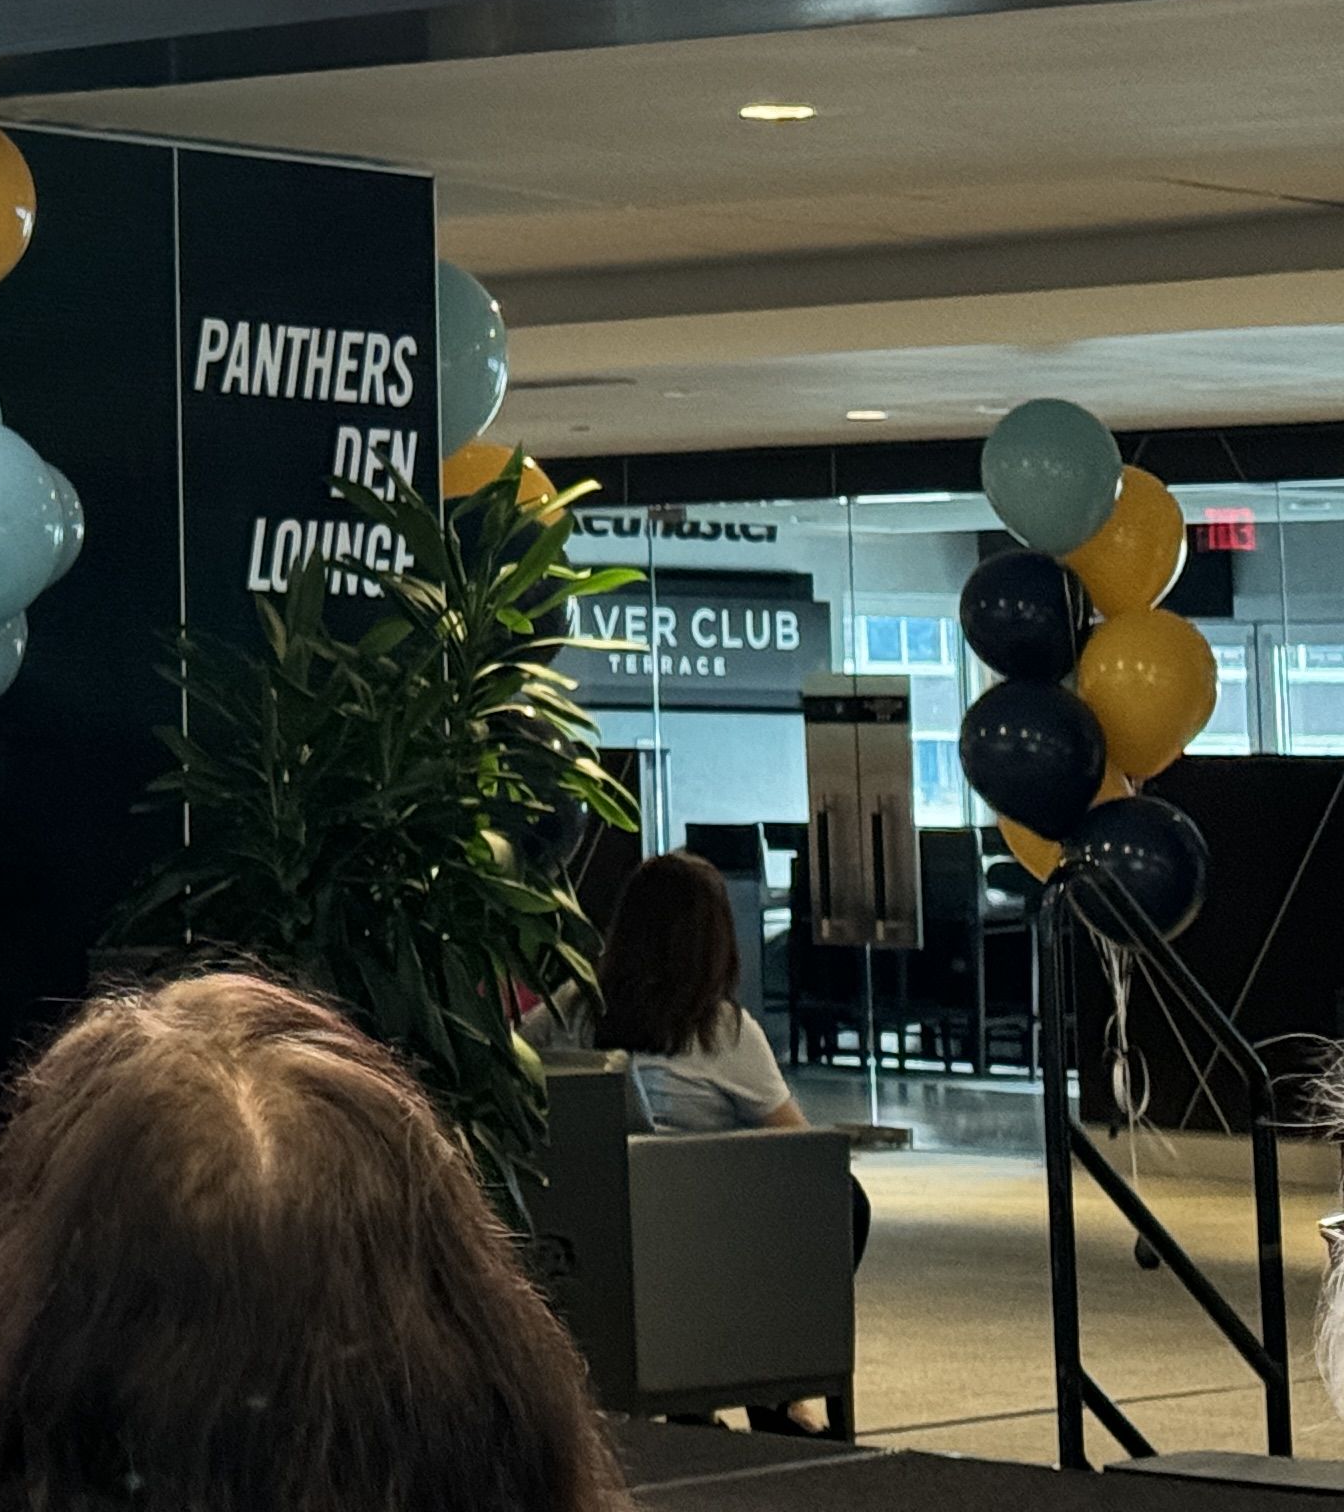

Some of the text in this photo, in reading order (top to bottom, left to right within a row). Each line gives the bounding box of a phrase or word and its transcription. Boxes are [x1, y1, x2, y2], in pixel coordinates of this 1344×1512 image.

[193, 317, 418, 408] PANTHERS
[330, 425, 418, 503] DEN
[691, 607, 801, 651] CLUB
[608, 653, 727, 676] TERRACE
